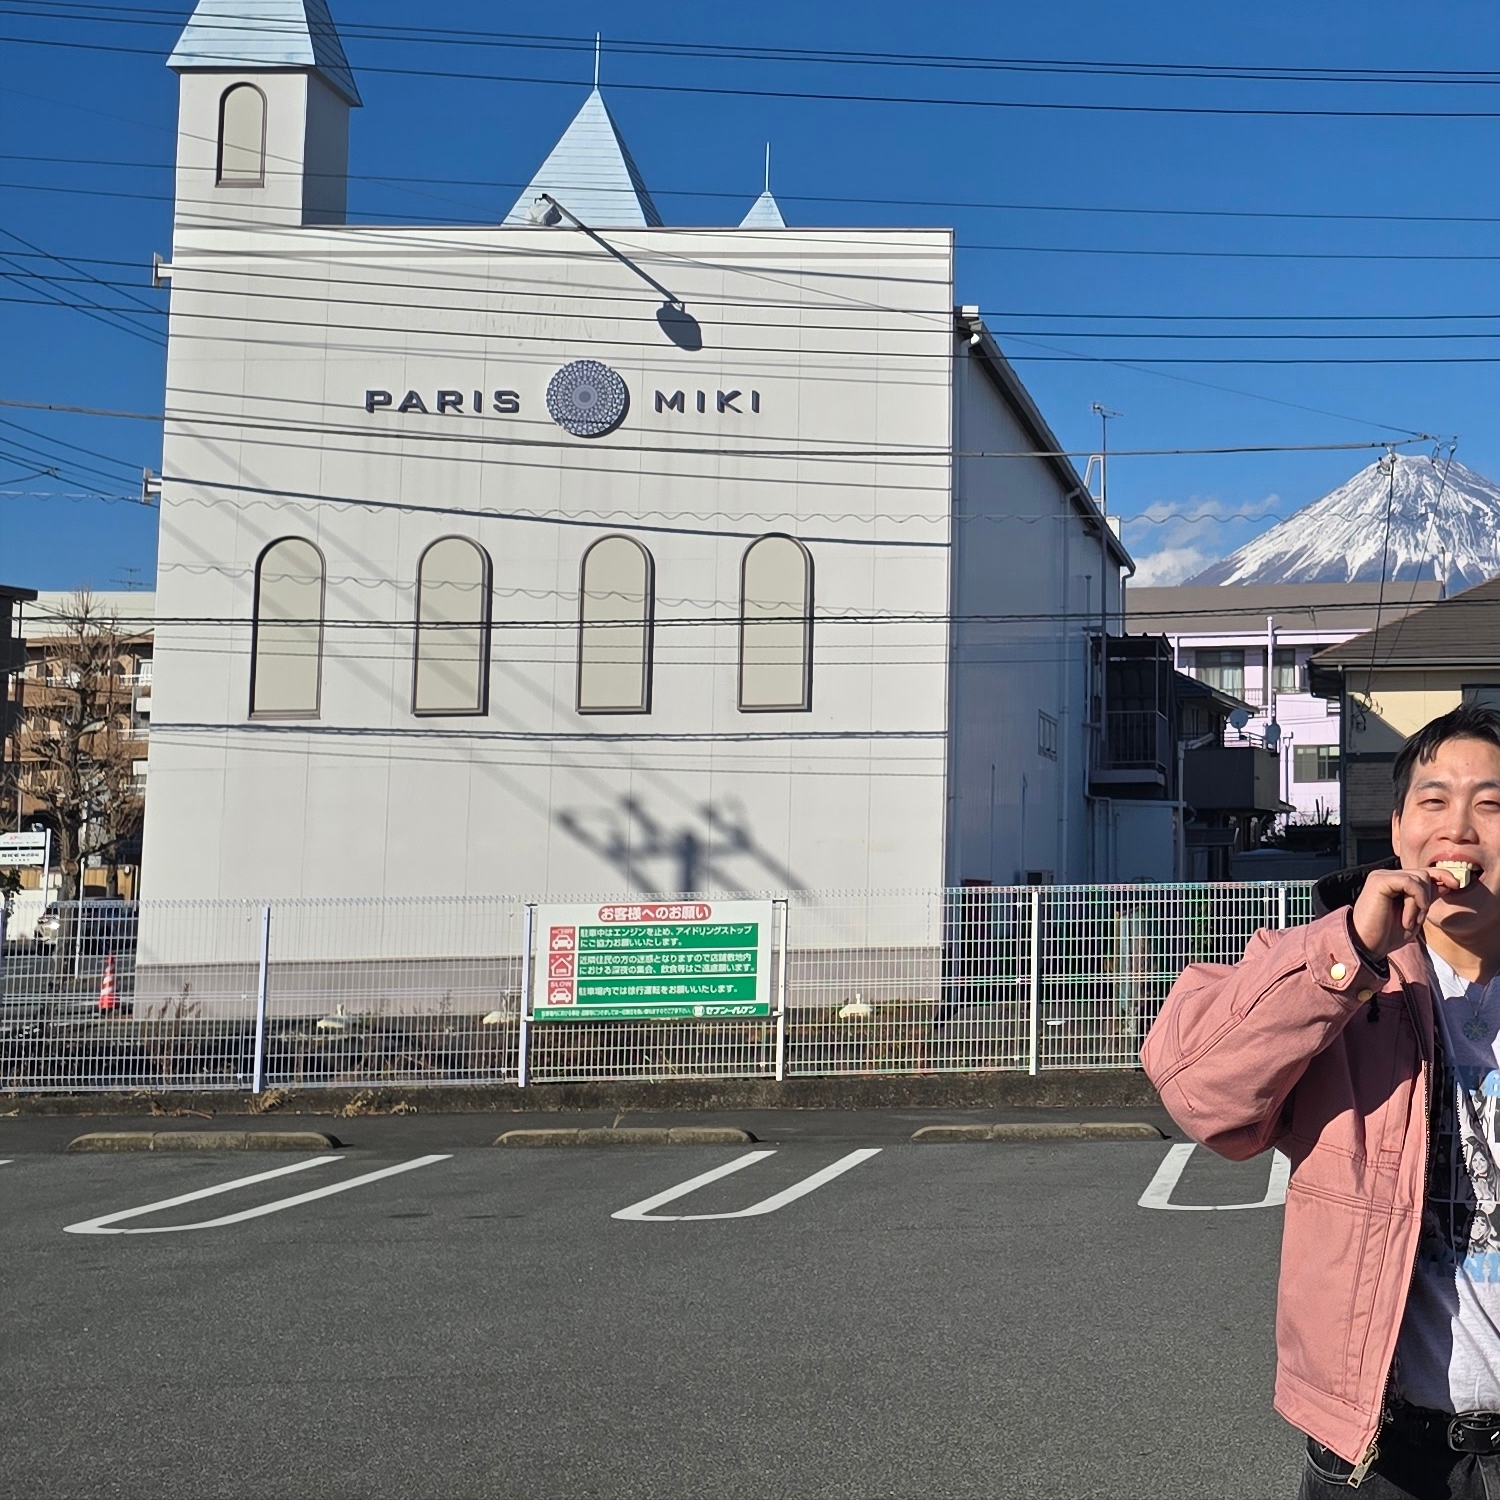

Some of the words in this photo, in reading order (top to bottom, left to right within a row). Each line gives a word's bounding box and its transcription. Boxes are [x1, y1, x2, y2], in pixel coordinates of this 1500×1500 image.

[365, 389, 520, 414] PARIS
[654, 389, 761, 414] MIKI
[601, 905, 709, 921] お客様へのお願い
